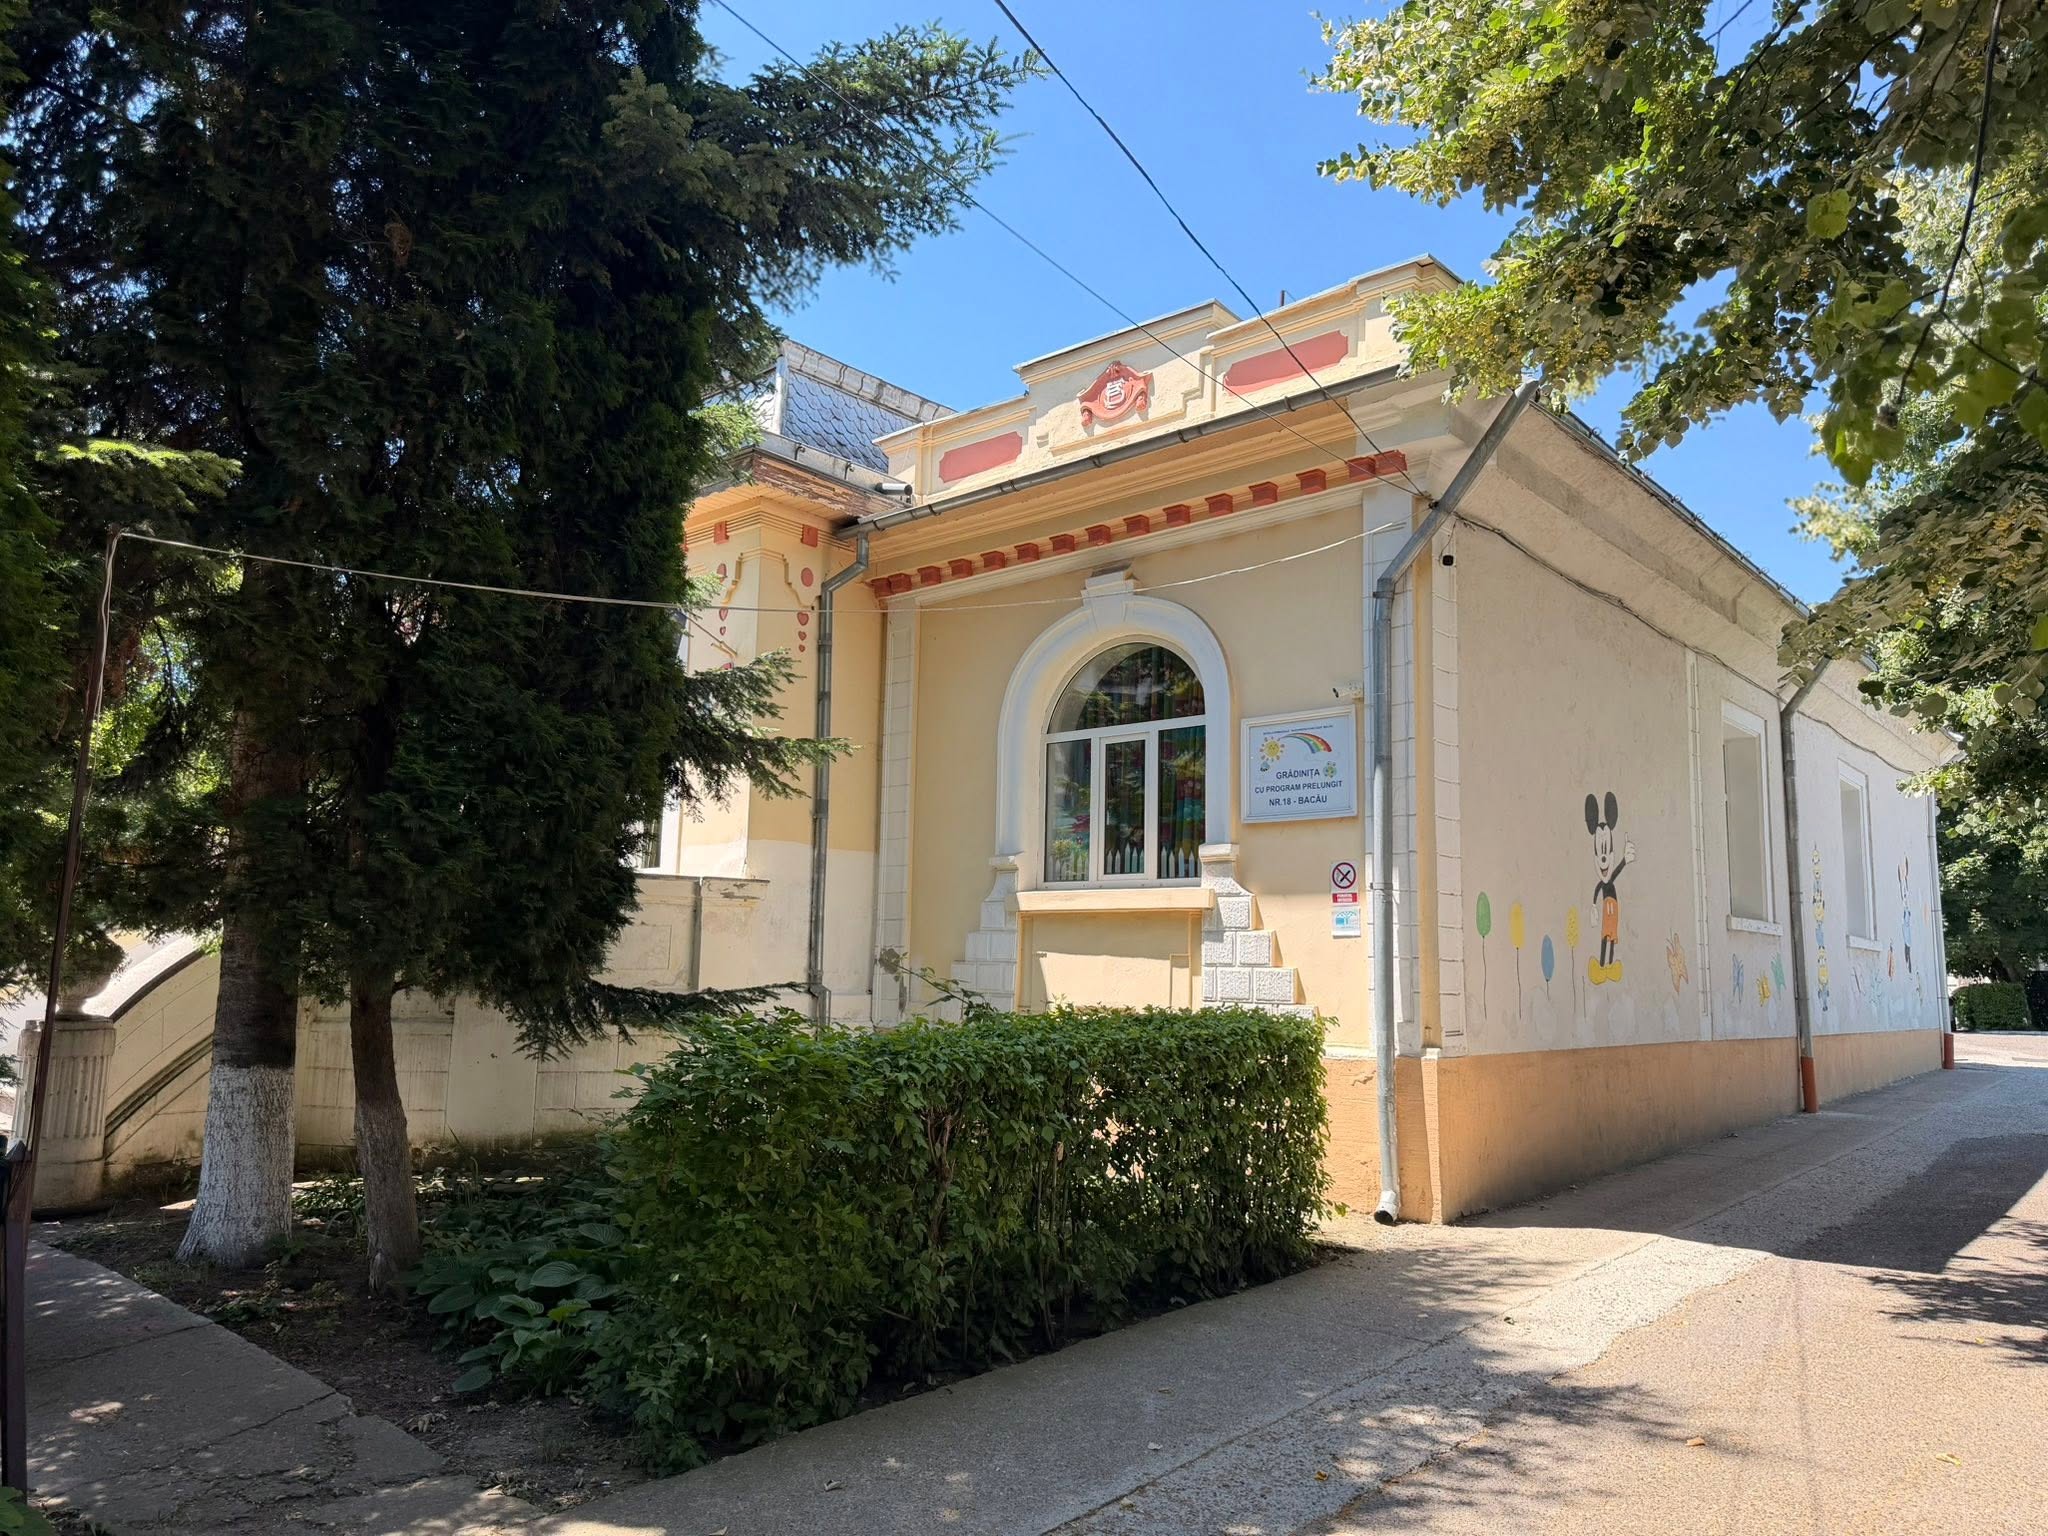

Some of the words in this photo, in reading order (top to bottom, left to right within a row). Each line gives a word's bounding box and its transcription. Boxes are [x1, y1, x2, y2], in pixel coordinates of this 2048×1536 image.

[1266, 784, 1301, 793] PROGRAM
[1302, 780, 1342, 790] PRELUNGIT
[1269, 798, 1291, 806] NR.18
[1298, 794, 1327, 805] BACĂU
